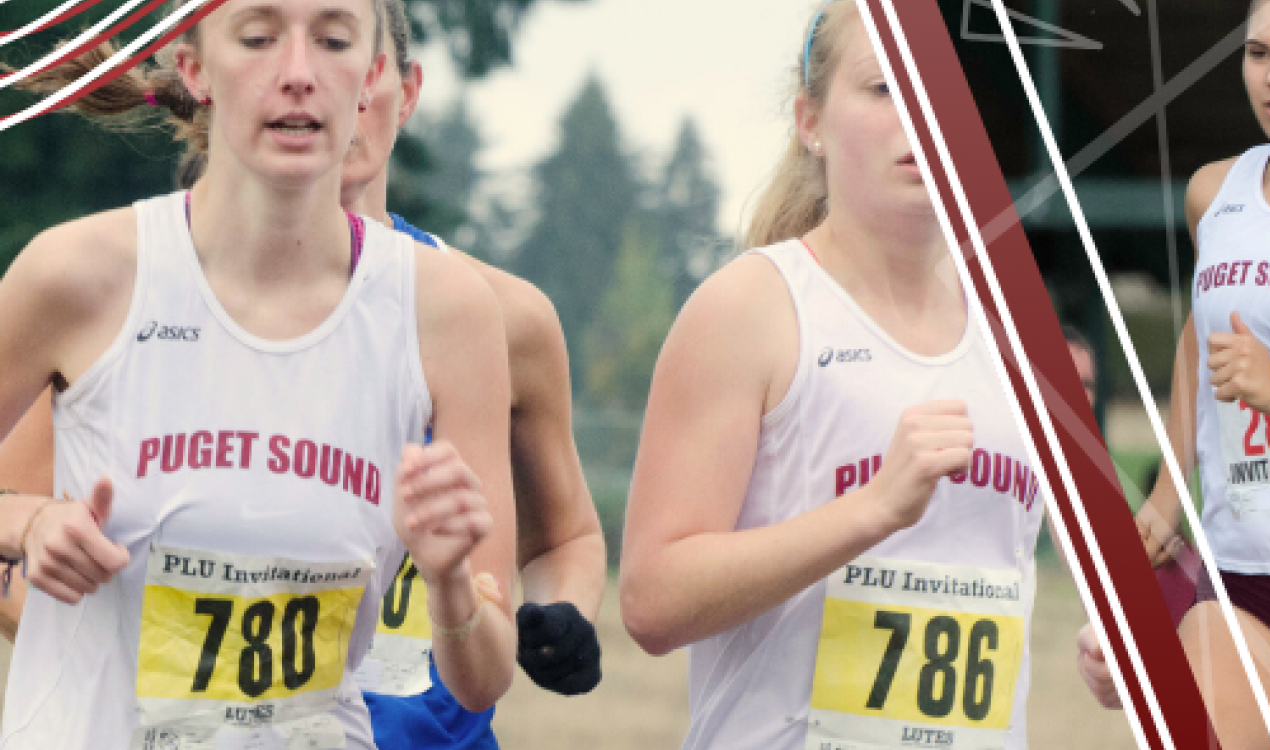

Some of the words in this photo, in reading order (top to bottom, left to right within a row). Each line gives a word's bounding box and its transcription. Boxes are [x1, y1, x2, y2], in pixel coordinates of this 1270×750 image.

[1195, 260, 1253, 299] PUGET
[136, 429, 259, 479] PUGET
[266, 432, 381, 507] SOUND
[162, 553, 216, 578] PLU
[221, 562, 362, 584] Invitational
[843, 564, 897, 590] PLU
[901, 571, 1019, 600] Invitational
[191, 595, 320, 698] 780
[864, 610, 999, 721] 786
